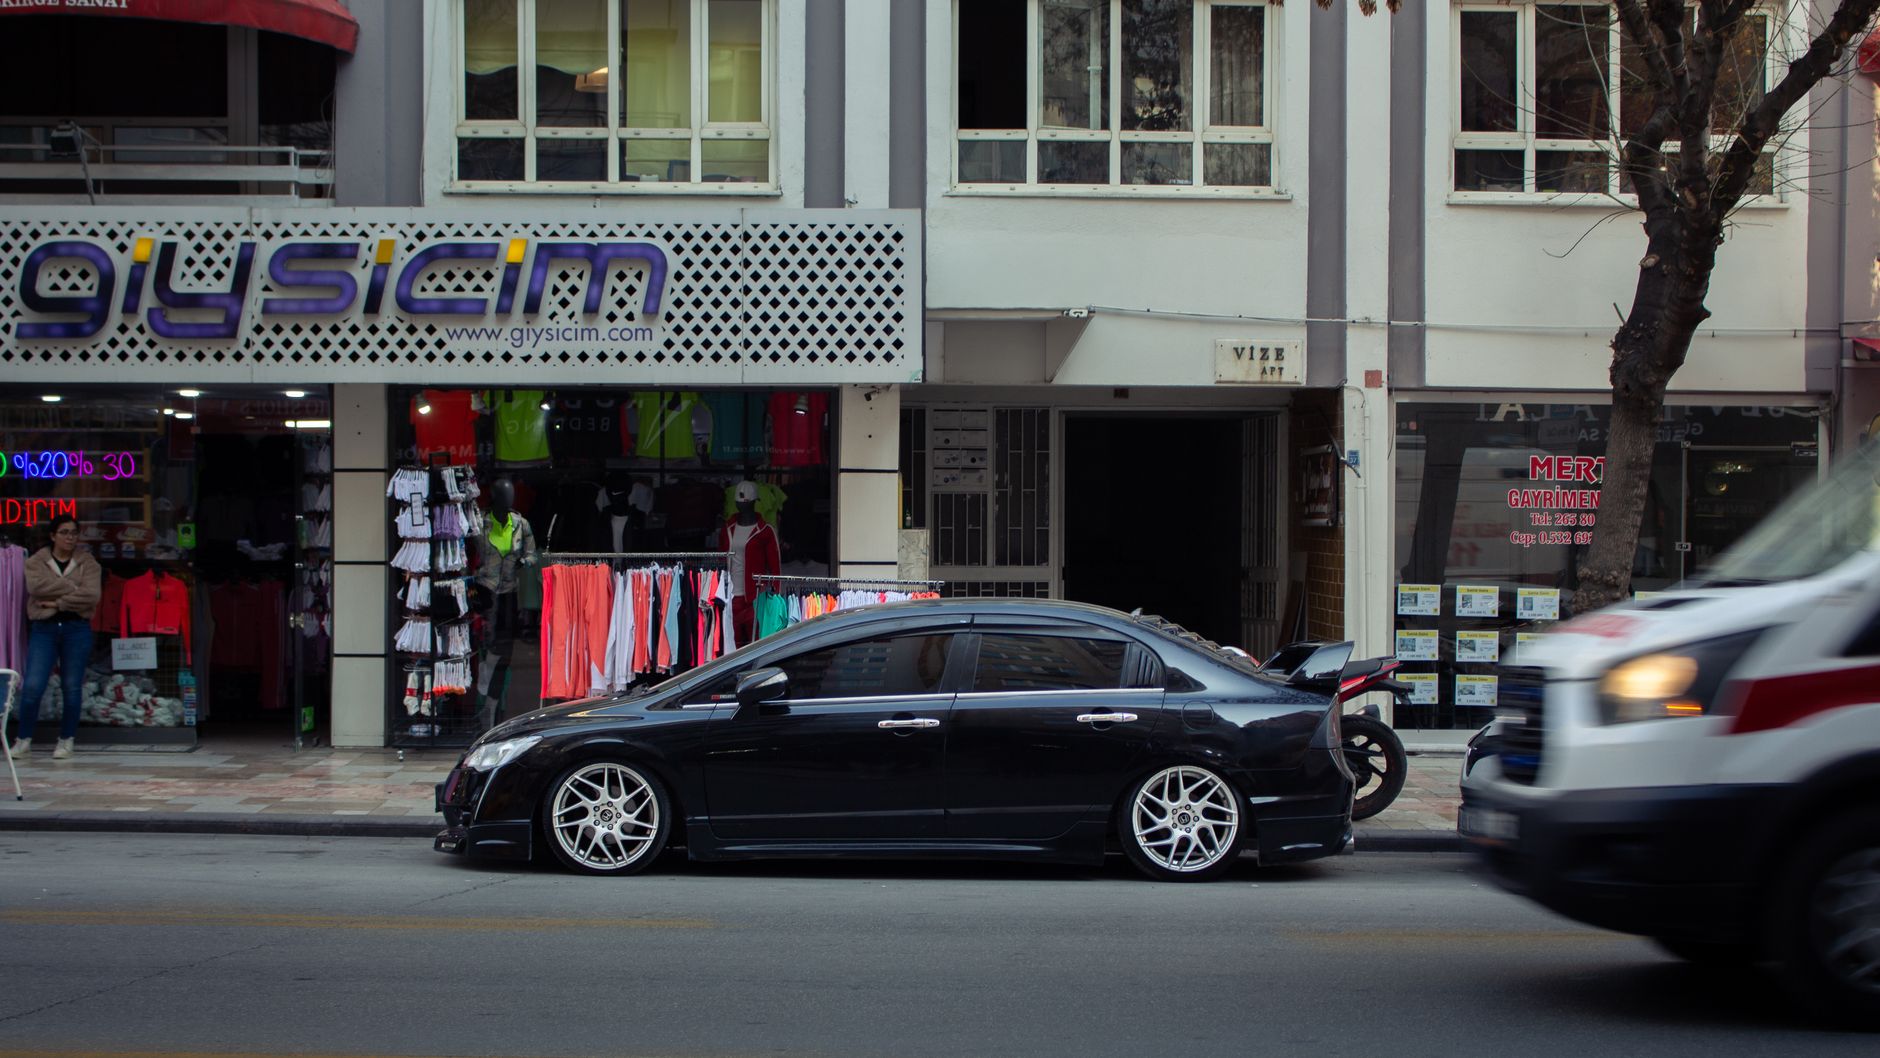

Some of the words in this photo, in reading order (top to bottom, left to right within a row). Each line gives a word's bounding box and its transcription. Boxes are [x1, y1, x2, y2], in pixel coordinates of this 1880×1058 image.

[15, 237, 668, 339] giysicim
[445, 326, 653, 348] www.giysicim.com
[103, 452, 136, 481] 30
[1530, 511, 1553, 526] Tel:
[1554, 513, 1577, 527] 265
[1579, 513, 1596, 527] 80
[1509, 530, 1537, 548] Cep:
[1538, 531, 1572, 545] 0.532
